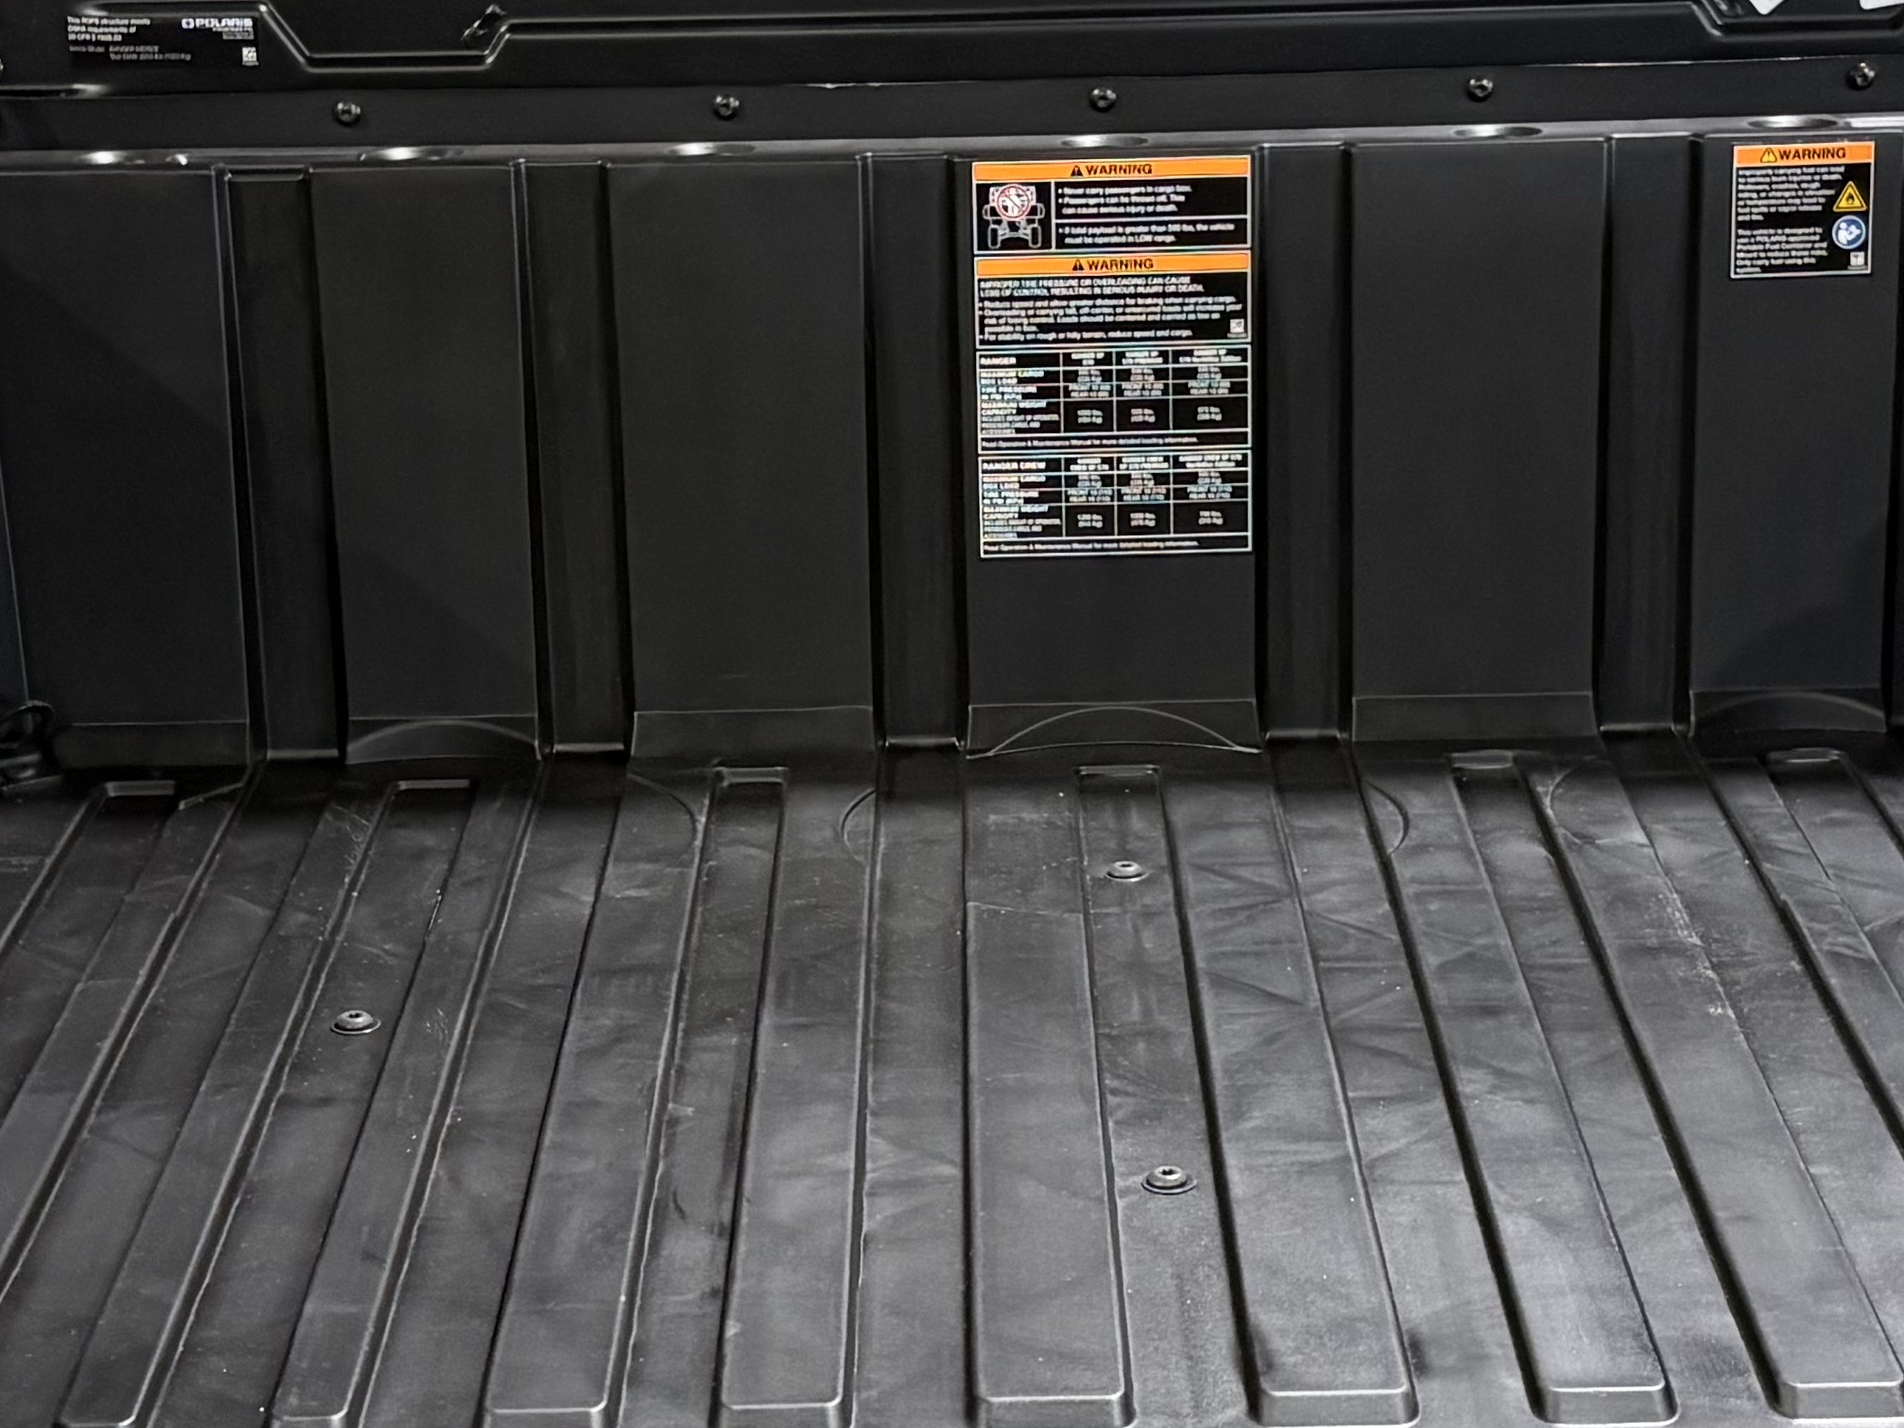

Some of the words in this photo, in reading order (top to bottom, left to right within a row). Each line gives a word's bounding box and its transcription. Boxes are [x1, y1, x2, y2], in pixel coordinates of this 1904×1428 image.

[1778, 148, 1846, 160] WARNING
[1085, 164, 1152, 175] WARNING
[1087, 259, 1153, 271] WARNING
